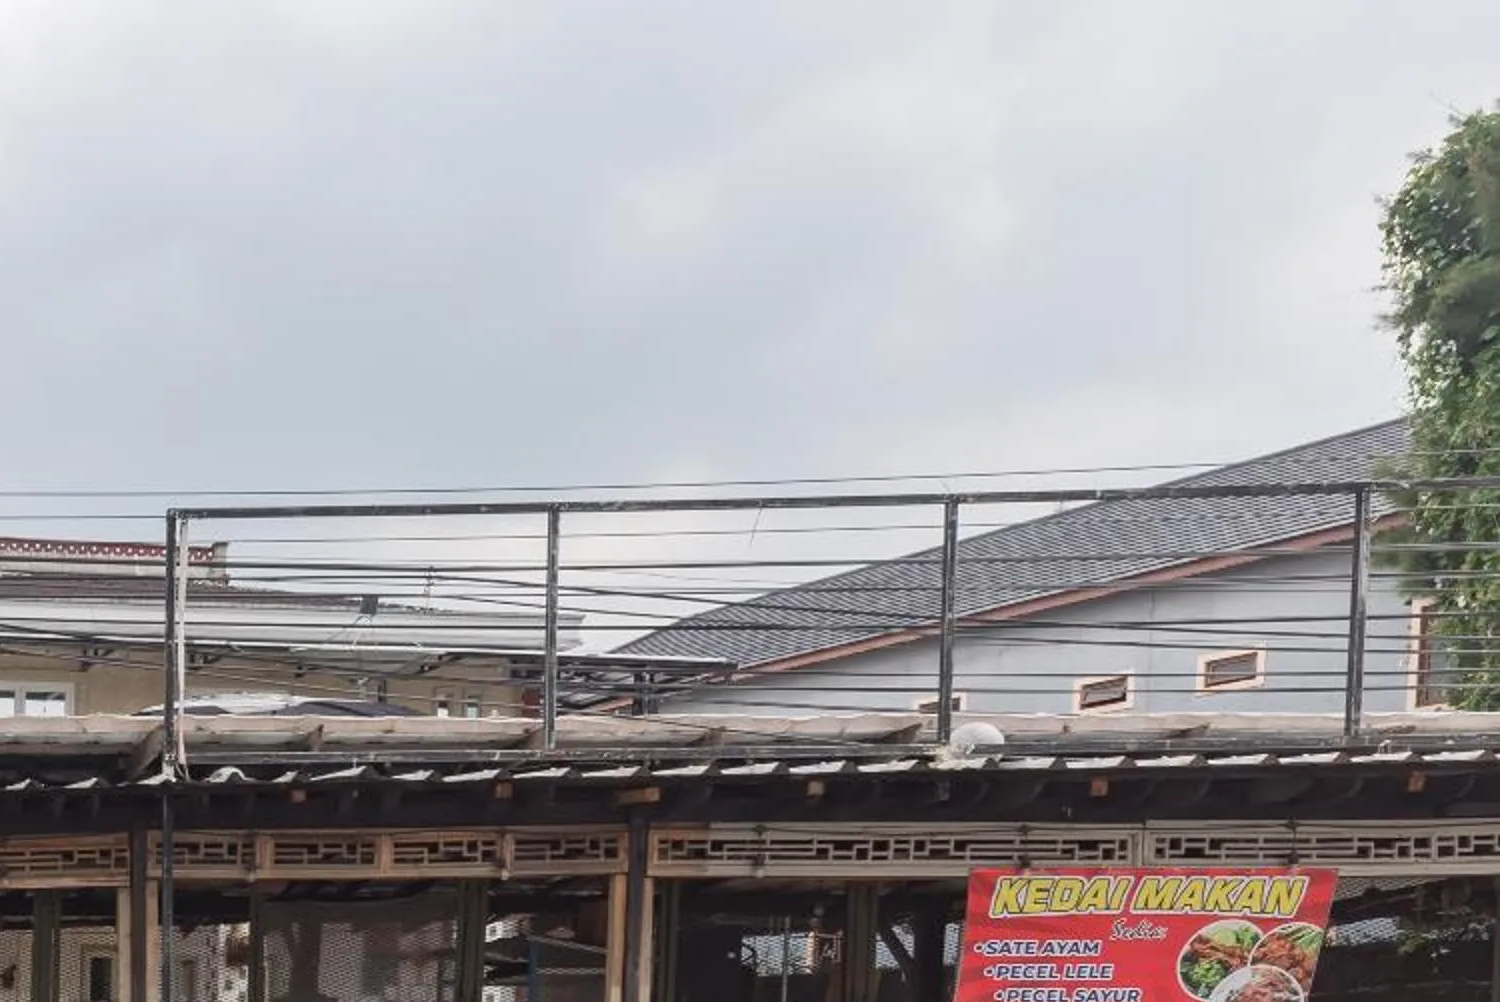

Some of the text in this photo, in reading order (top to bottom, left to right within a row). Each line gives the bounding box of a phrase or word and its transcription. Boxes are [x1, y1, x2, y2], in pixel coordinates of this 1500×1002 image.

[990, 876, 1309, 918] KEDAI MAKAN
[984, 940, 1101, 956] SATE AYAM
[995, 964, 1114, 980] PECEL LELE
